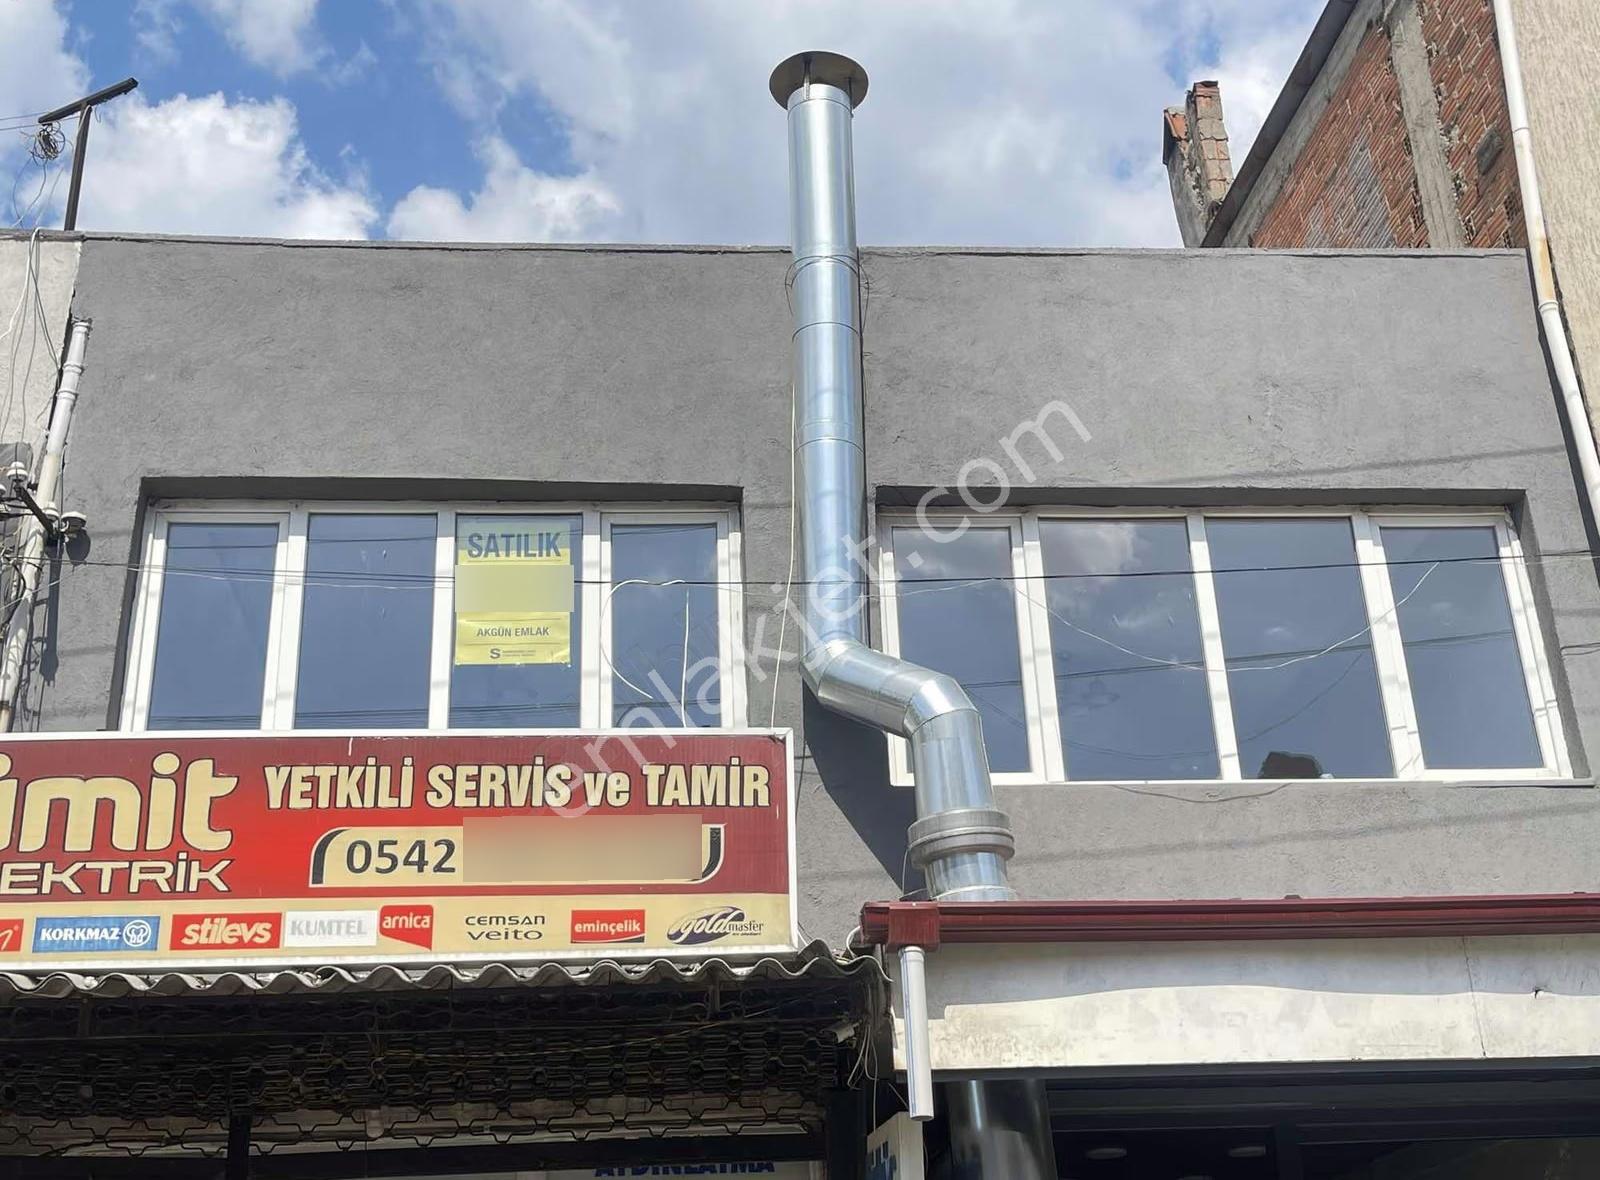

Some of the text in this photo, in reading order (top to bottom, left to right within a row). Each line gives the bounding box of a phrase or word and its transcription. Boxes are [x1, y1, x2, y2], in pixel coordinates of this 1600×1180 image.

[467, 532, 561, 558] SATILIK
[476, 626, 550, 637] AKGÜN EMLAK
[264, 755, 771, 810] YETKİLİ SERVİS ve TAMİR
[0, 752, 240, 853] mit
[346, 838, 456, 875] 0542
[291, 919, 368, 937] KUMTEL
[383, 912, 431, 929] arnica
[574, 919, 641, 936] eminçelik
[40, 927, 120, 942] KORKMAZ
[181, 917, 272, 945] stilevs
[467, 927, 543, 941] veito
